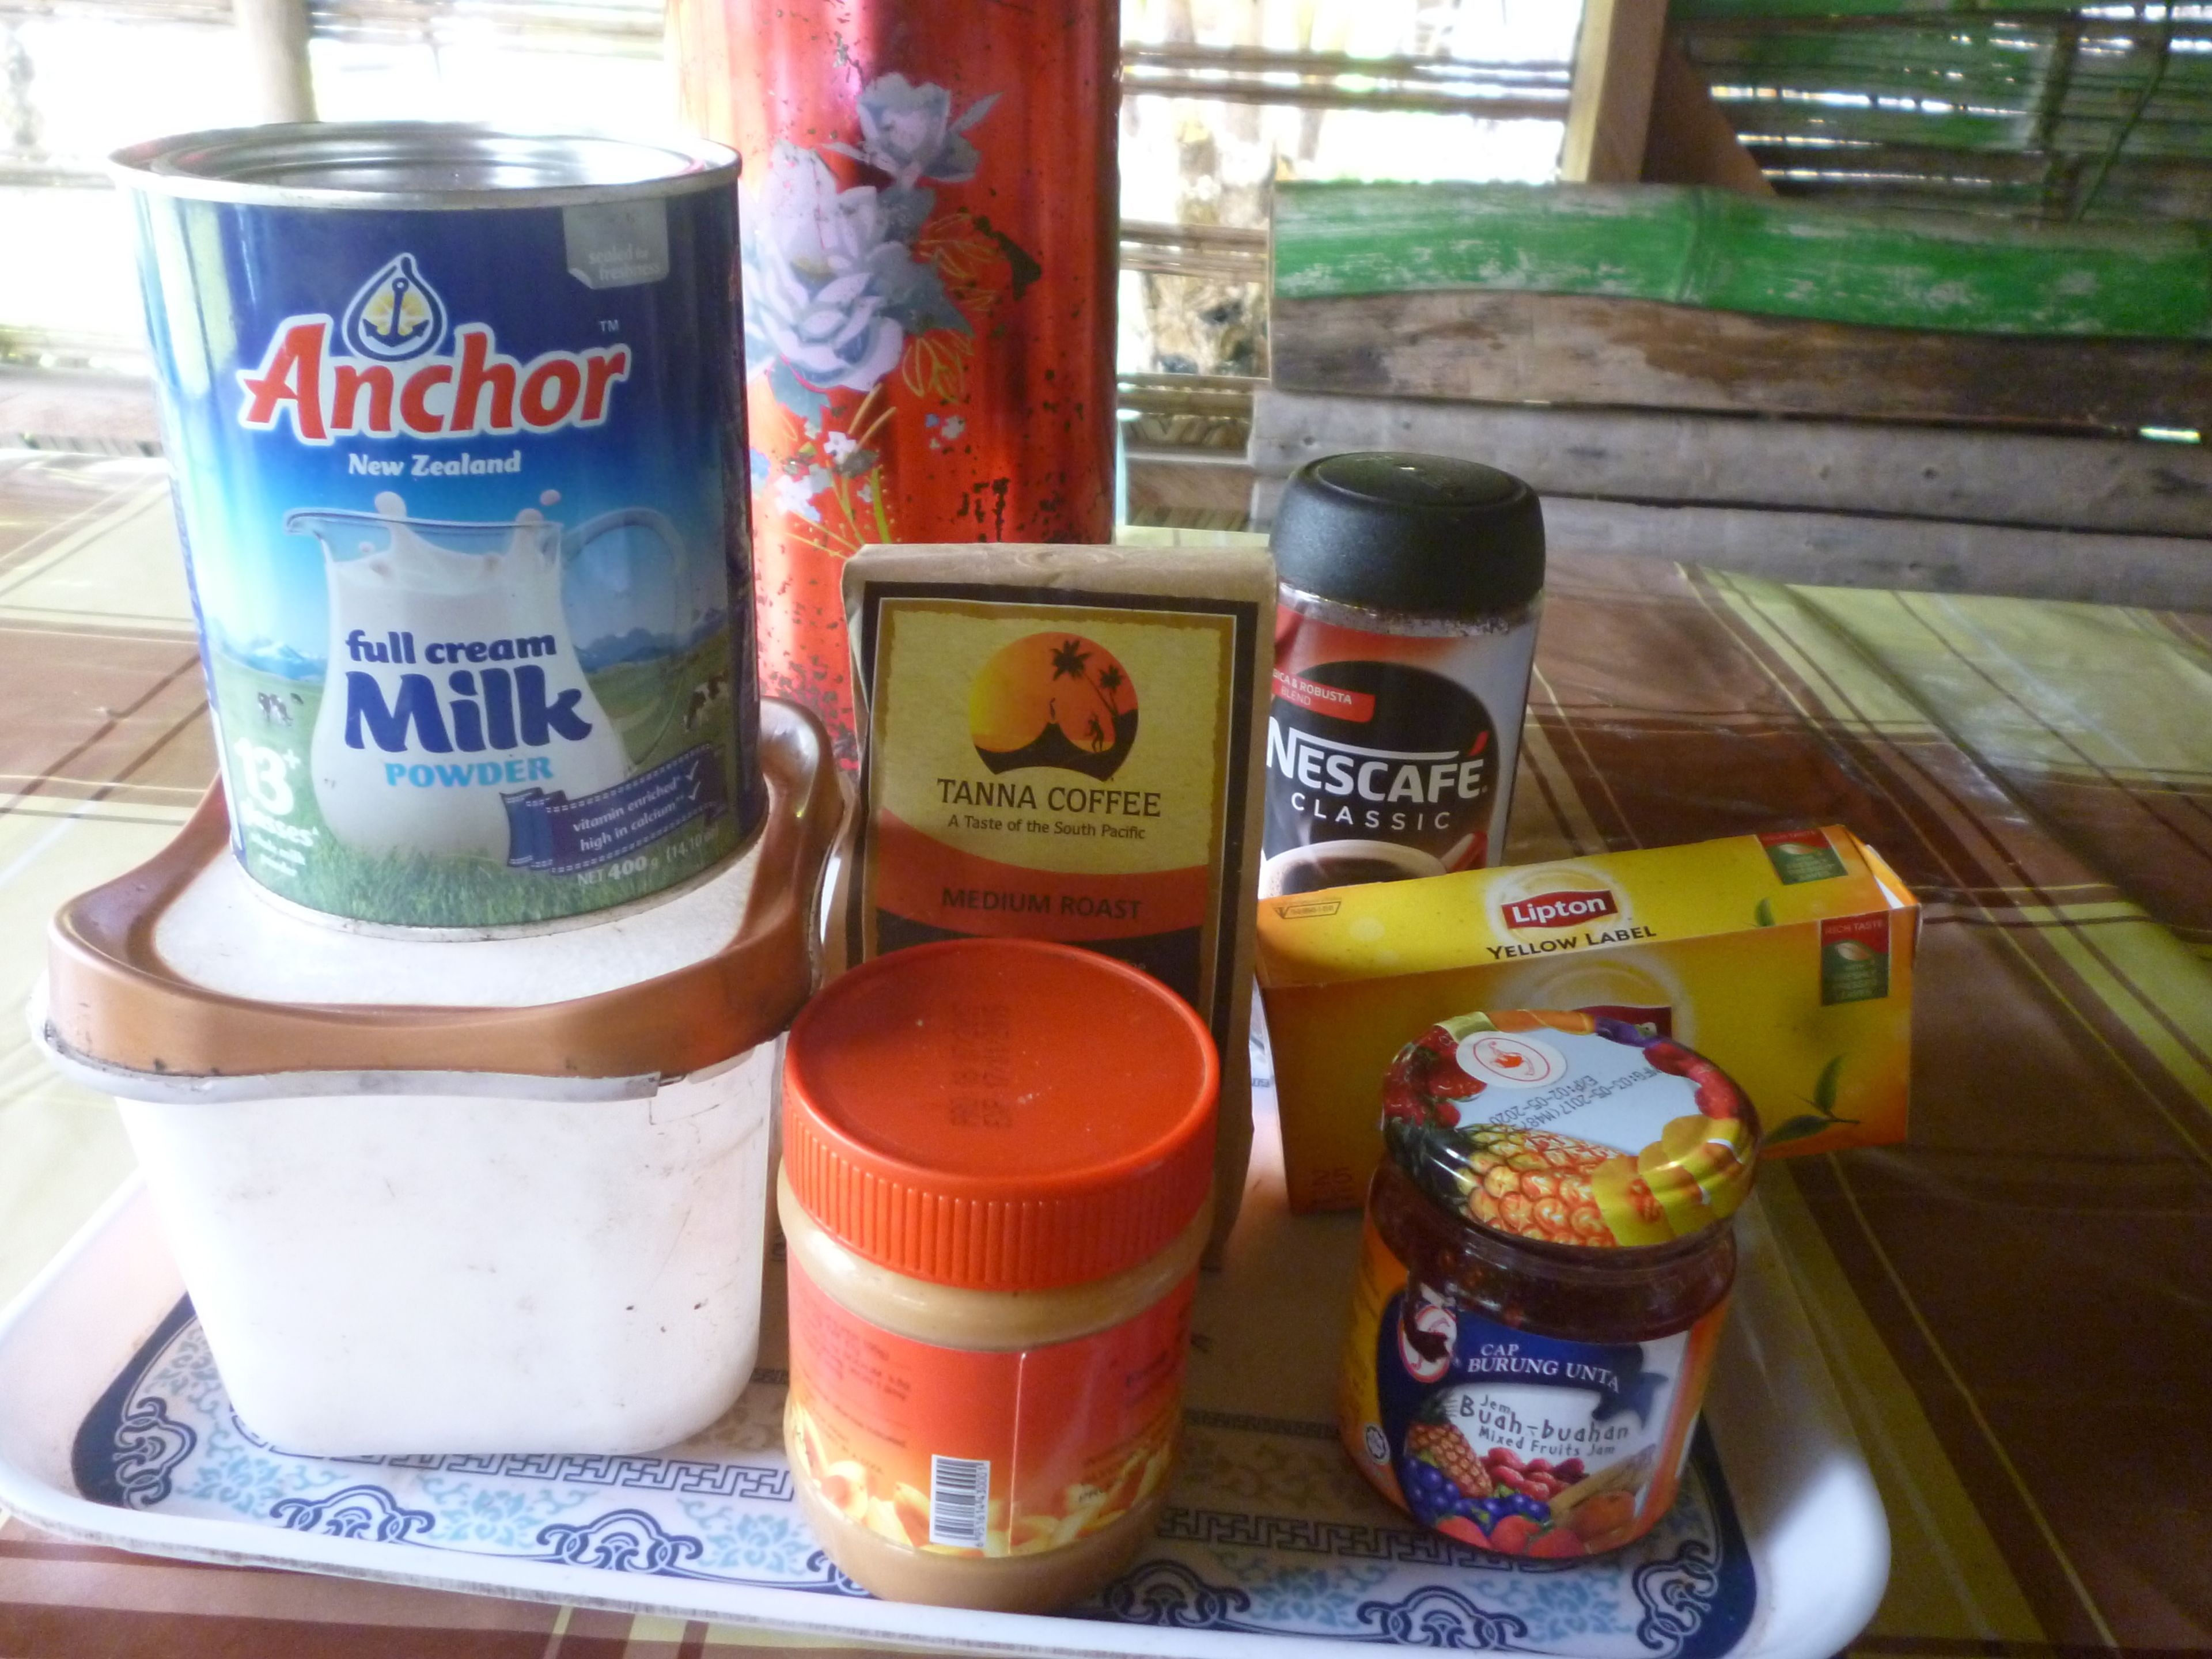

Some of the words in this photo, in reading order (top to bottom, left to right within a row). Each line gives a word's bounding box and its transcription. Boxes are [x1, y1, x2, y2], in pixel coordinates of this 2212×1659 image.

[241, 319, 627, 441] Anchor
[349, 453, 404, 476] New
[411, 449, 522, 476] Zealand
[346, 630, 415, 664] full
[425, 633, 557, 664] cream
[345, 664, 593, 753] Milk
[1281, 685, 1312, 706] BLEND
[1300, 681, 1353, 705] ROBUSTA
[384, 756, 554, 788] POWDER
[937, 778, 1037, 809] TANNA
[1047, 787, 1161, 817] COFFEE
[1291, 791, 1450, 831] CLASSIC
[573, 807, 625, 832] vitamin
[948, 815, 959, 828] A
[964, 815, 1002, 831] Taste
[1007, 818, 1024, 832] of
[1026, 819, 1050, 834] the
[1054, 820, 1096, 837] South
[1101, 824, 1146, 841] Pacific
[580, 832, 612, 851] high
[615, 825, 628, 839] in
[577, 868, 604, 887] NET
[607, 855, 647, 880] 400
[942, 887, 1051, 915] MEDIUM
[1060, 896, 1142, 920] ROAST
[1512, 897, 1607, 924] Lipton
[1486, 936, 1577, 960] YELLOW
[1585, 925, 1657, 946] LABEL
[1480, 1344, 1520, 1357] CAP
[1467, 1357, 1560, 1376] BURUNG
[1566, 1362, 1619, 1393] UNTA
[1479, 1394, 1512, 1413] Jem
[1478, 1426, 1525, 1450] Mixed
[1531, 1439, 1580, 1457] Fruits
[1587, 1443, 1616, 1457] Jam
